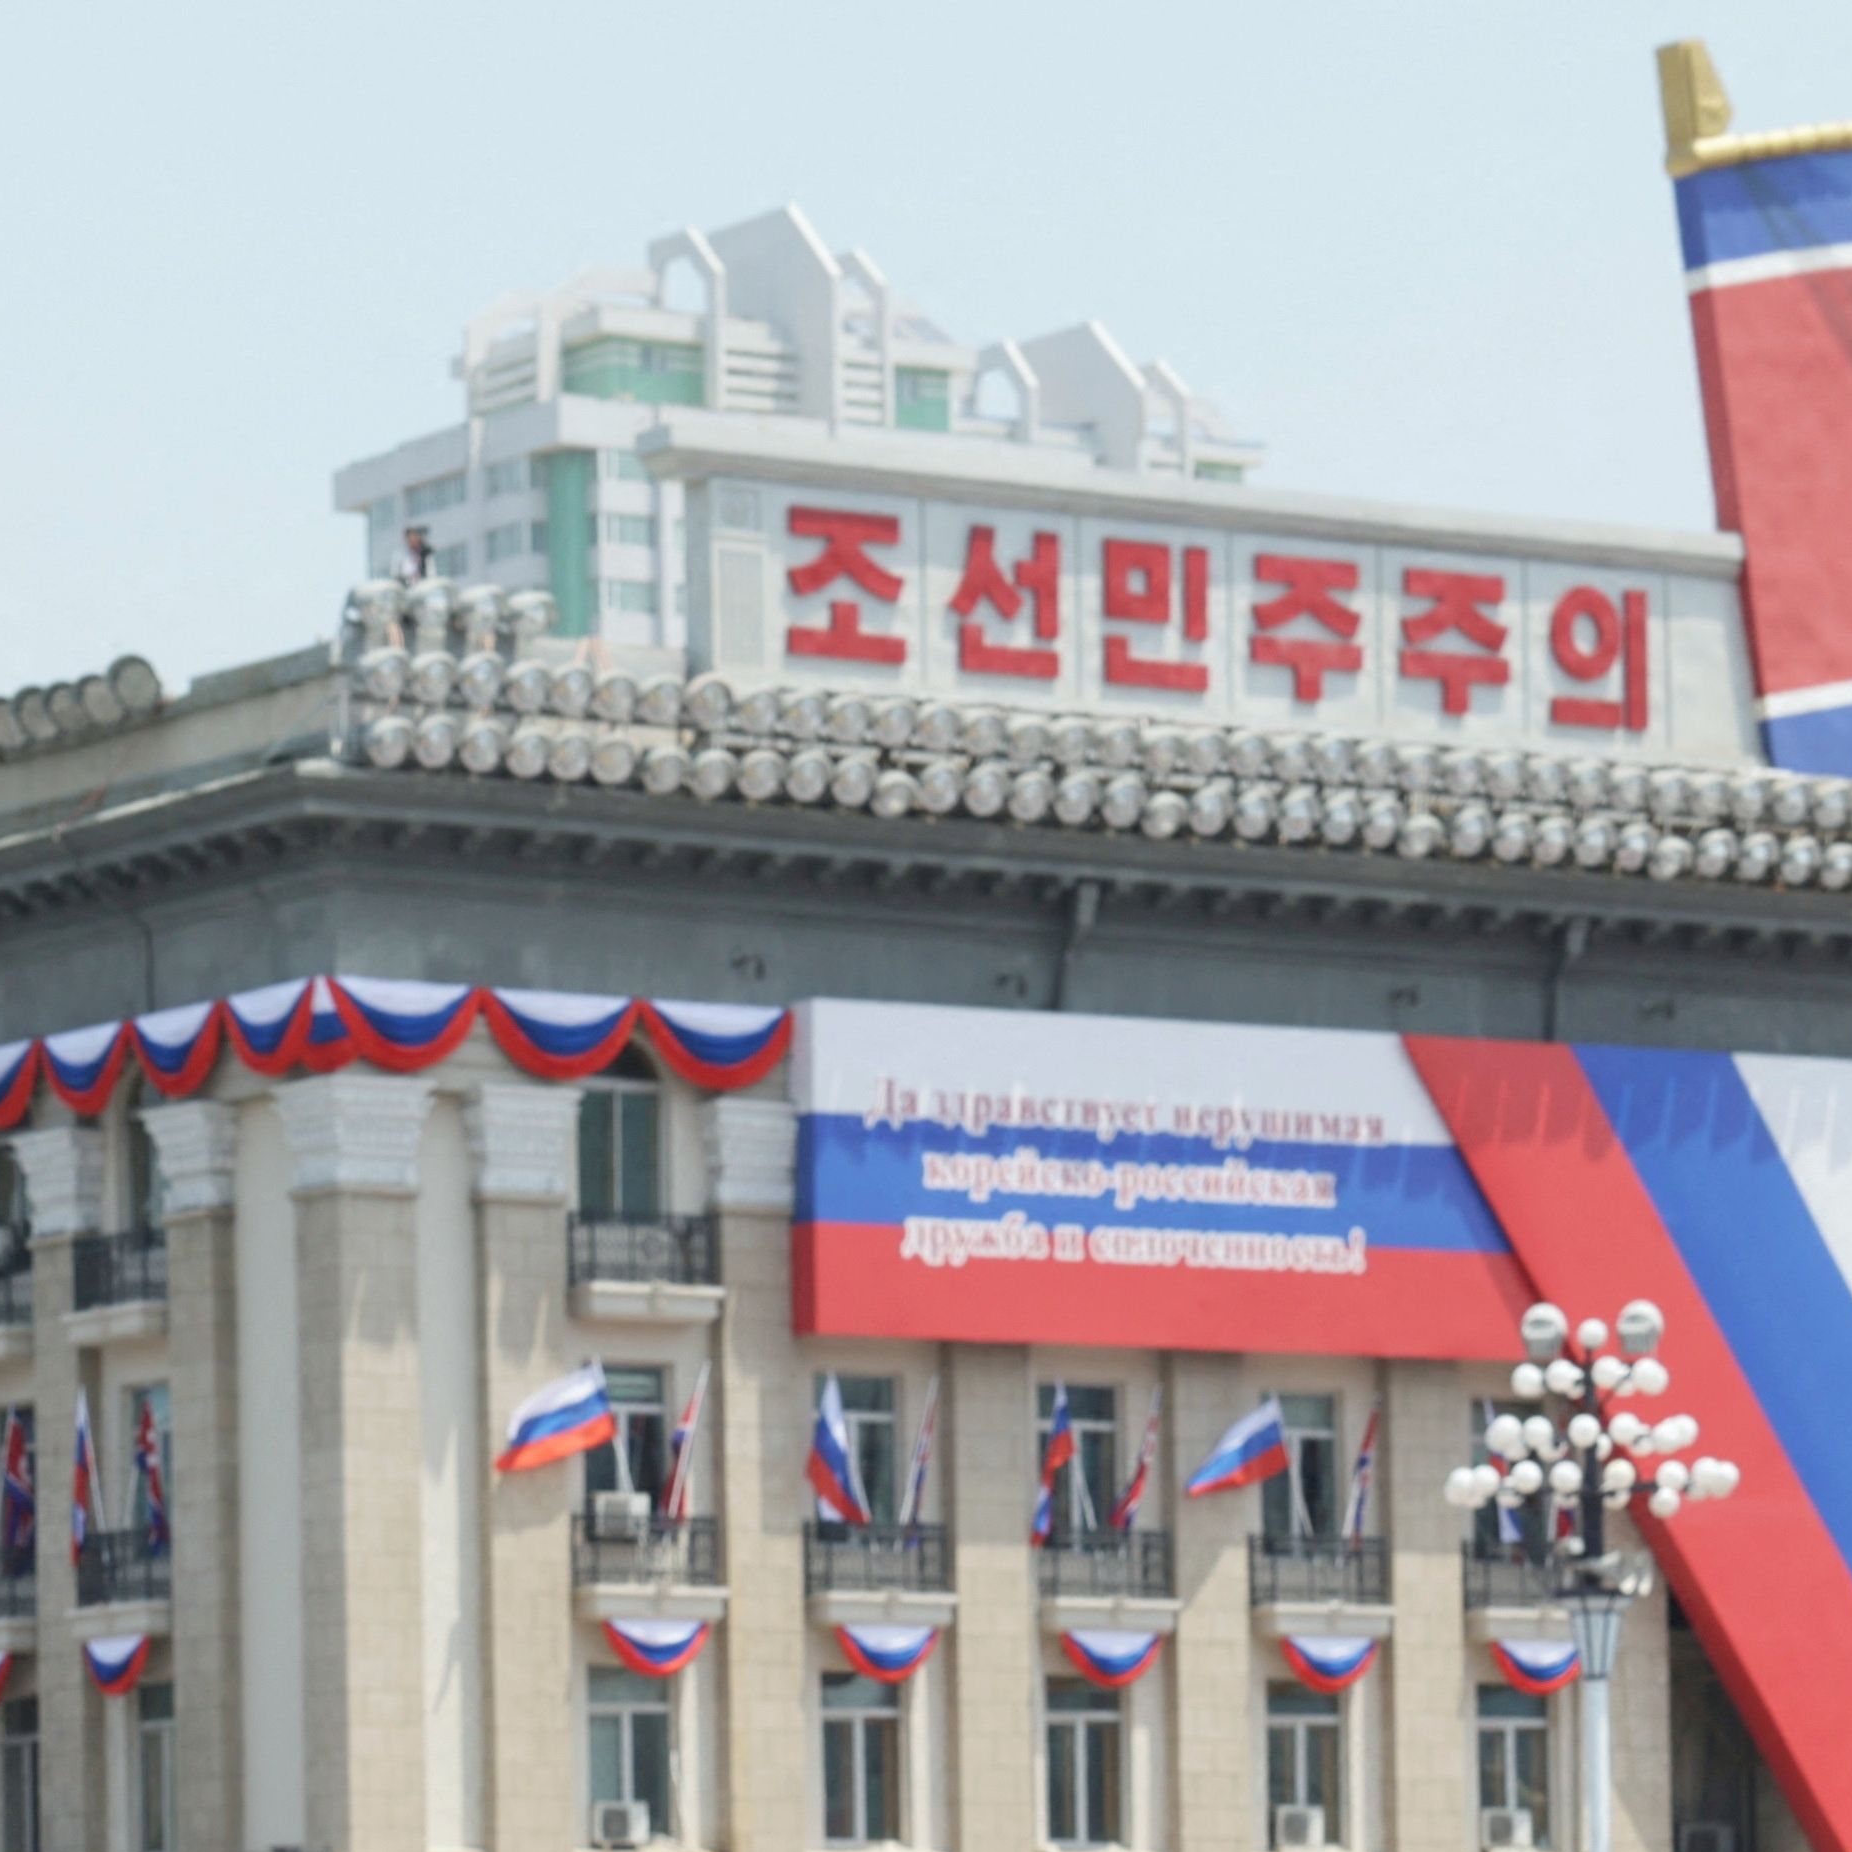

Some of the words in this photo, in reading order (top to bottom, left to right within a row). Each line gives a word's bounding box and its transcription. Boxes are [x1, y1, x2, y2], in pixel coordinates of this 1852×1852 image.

[786, 504, 1649, 732] 조선민주주의
[867, 1079, 919, 1125] Да
[935, 1090, 1157, 1138] здравствует
[1173, 1104, 1386, 1147] нерушимая
[925, 1150, 1335, 1207] корейско-российская
[903, 1213, 1048, 1265] дружба
[1055, 1228, 1084, 1259] и
